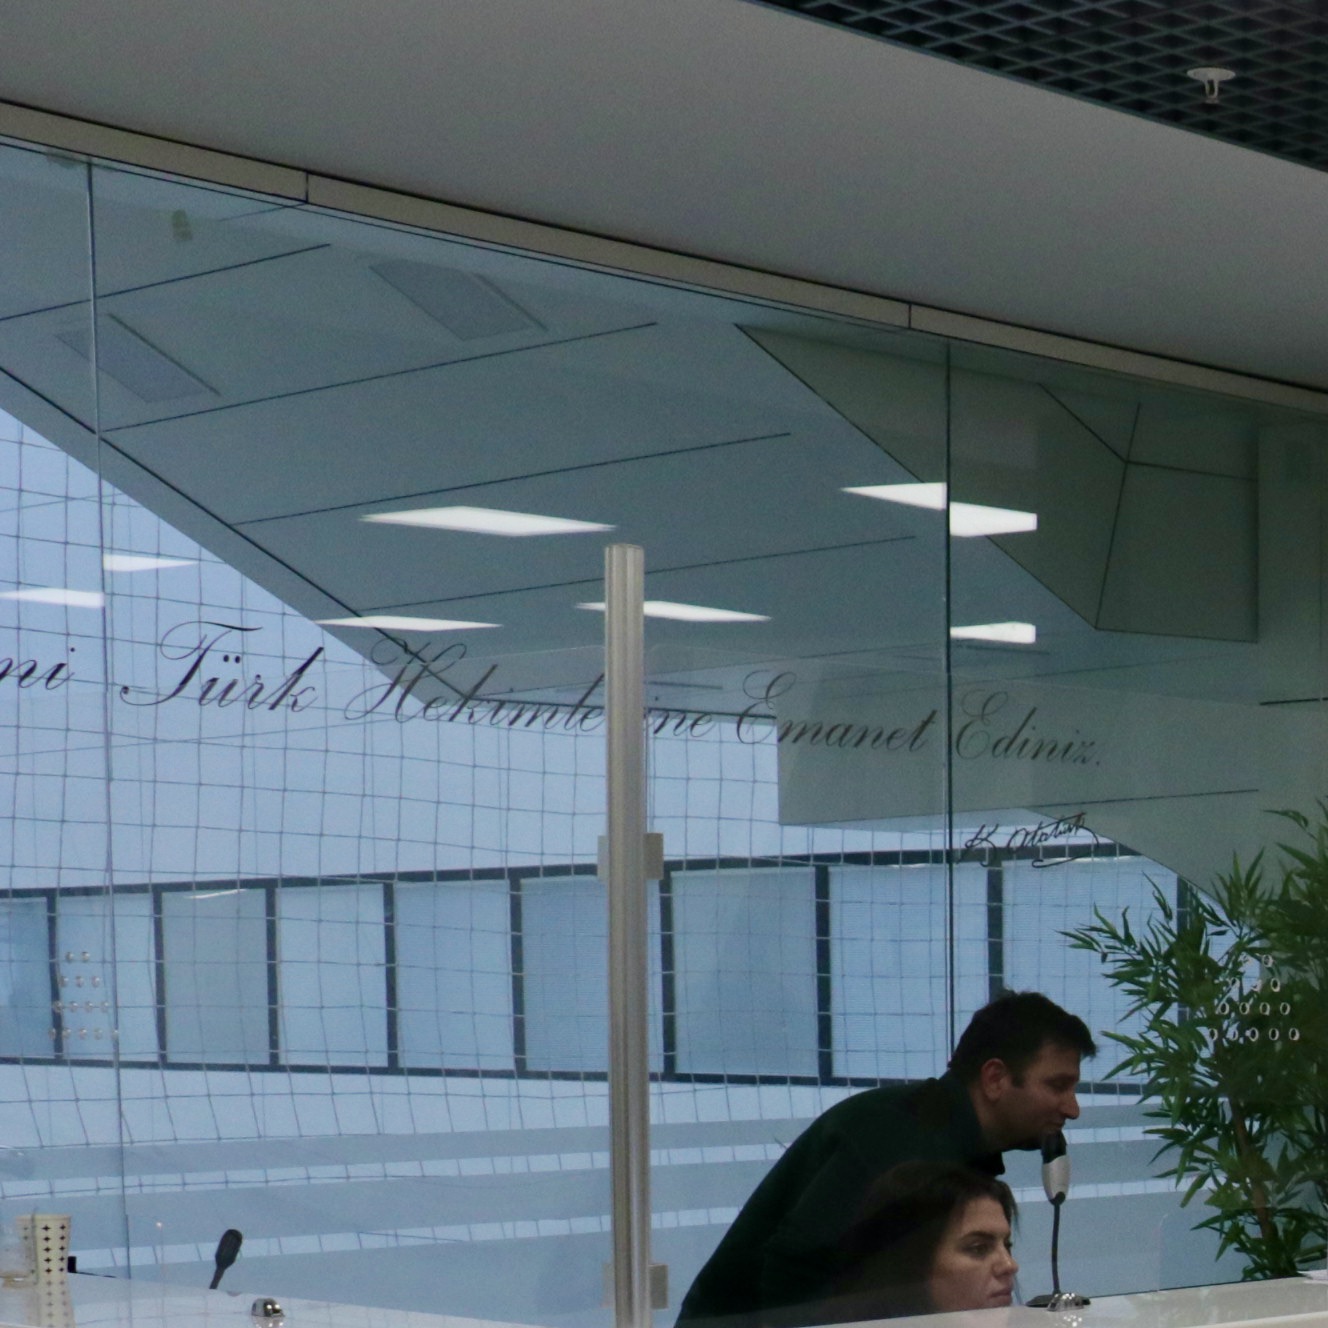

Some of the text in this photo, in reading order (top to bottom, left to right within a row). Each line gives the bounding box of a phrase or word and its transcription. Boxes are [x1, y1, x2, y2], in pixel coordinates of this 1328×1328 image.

[120, 620, 325, 713] Türk
[343, 643, 716, 738] Hekimleine
[736, 669, 938, 753] Emanet
